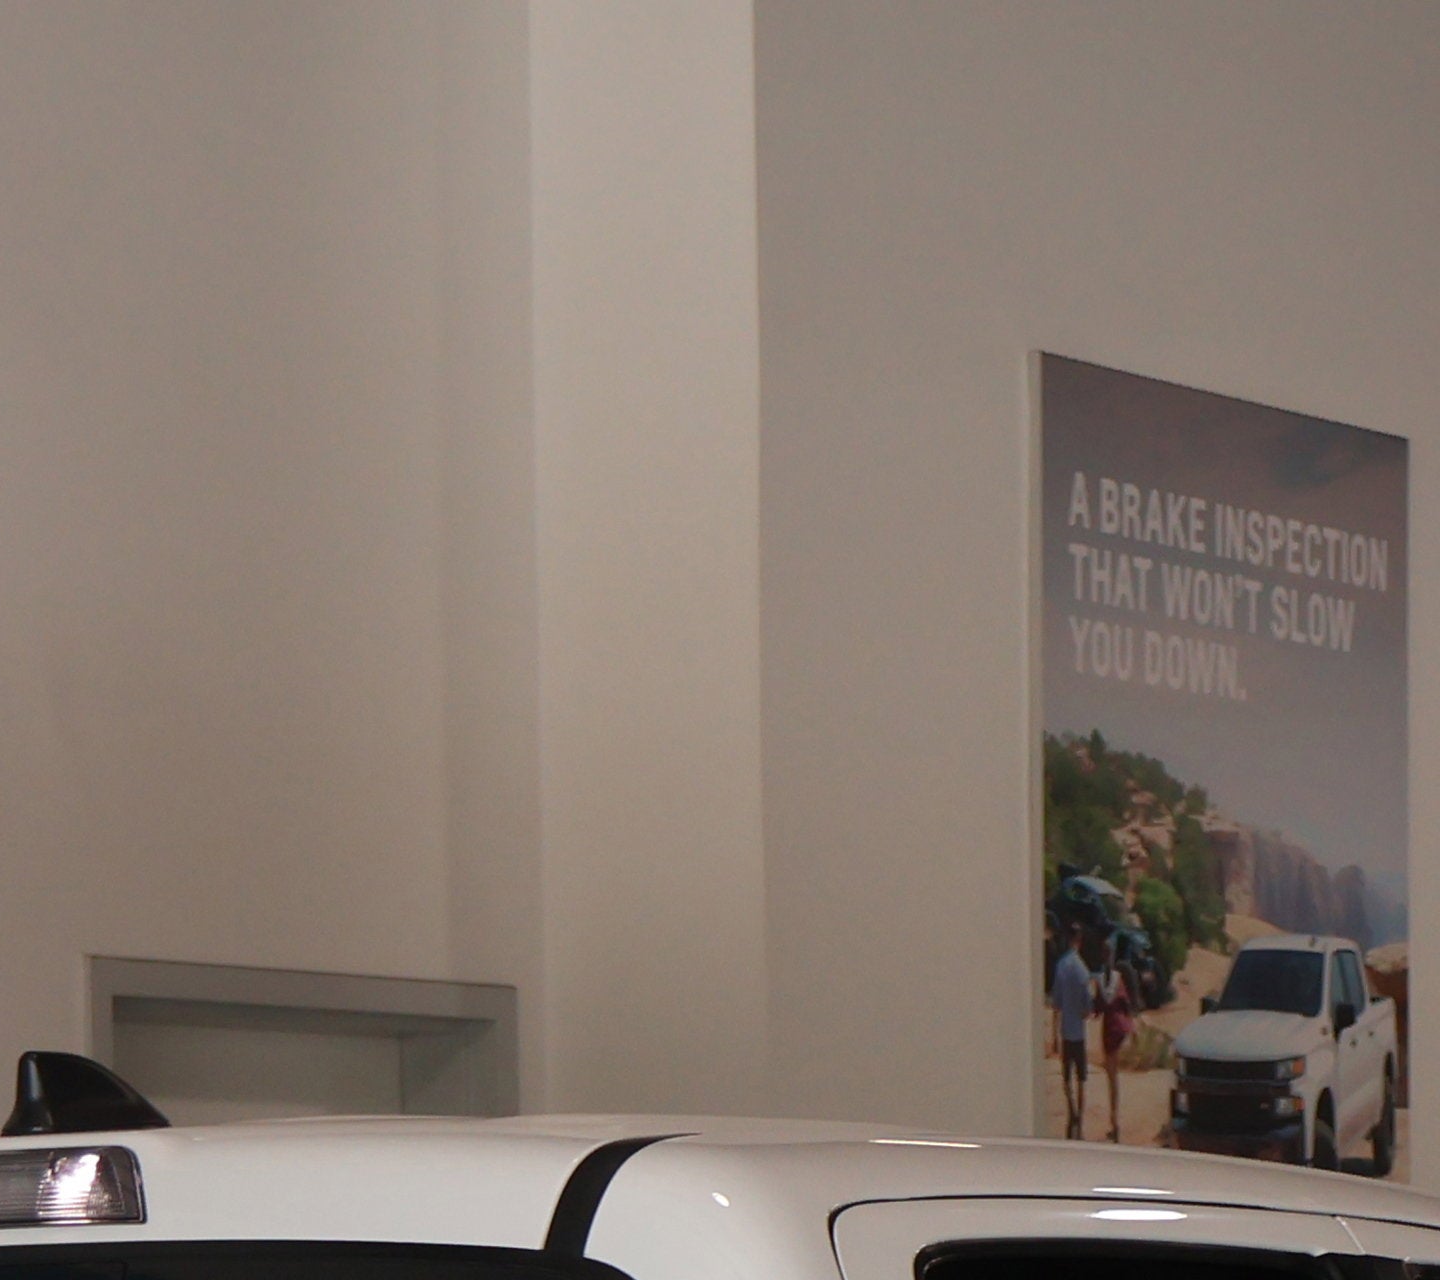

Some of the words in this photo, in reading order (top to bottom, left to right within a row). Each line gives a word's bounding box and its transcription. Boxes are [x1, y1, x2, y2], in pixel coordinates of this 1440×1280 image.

[1068, 470, 1091, 529] A
[1099, 477, 1207, 553] BRAKE
[1214, 503, 1388, 592] INSPECTION
[1068, 543, 1153, 612] THAT
[1161, 562, 1263, 634] WON'T
[1271, 585, 1356, 653] SLOW
[1069, 613, 1134, 682] YOU
[1143, 629, 1247, 700] DOWN.
